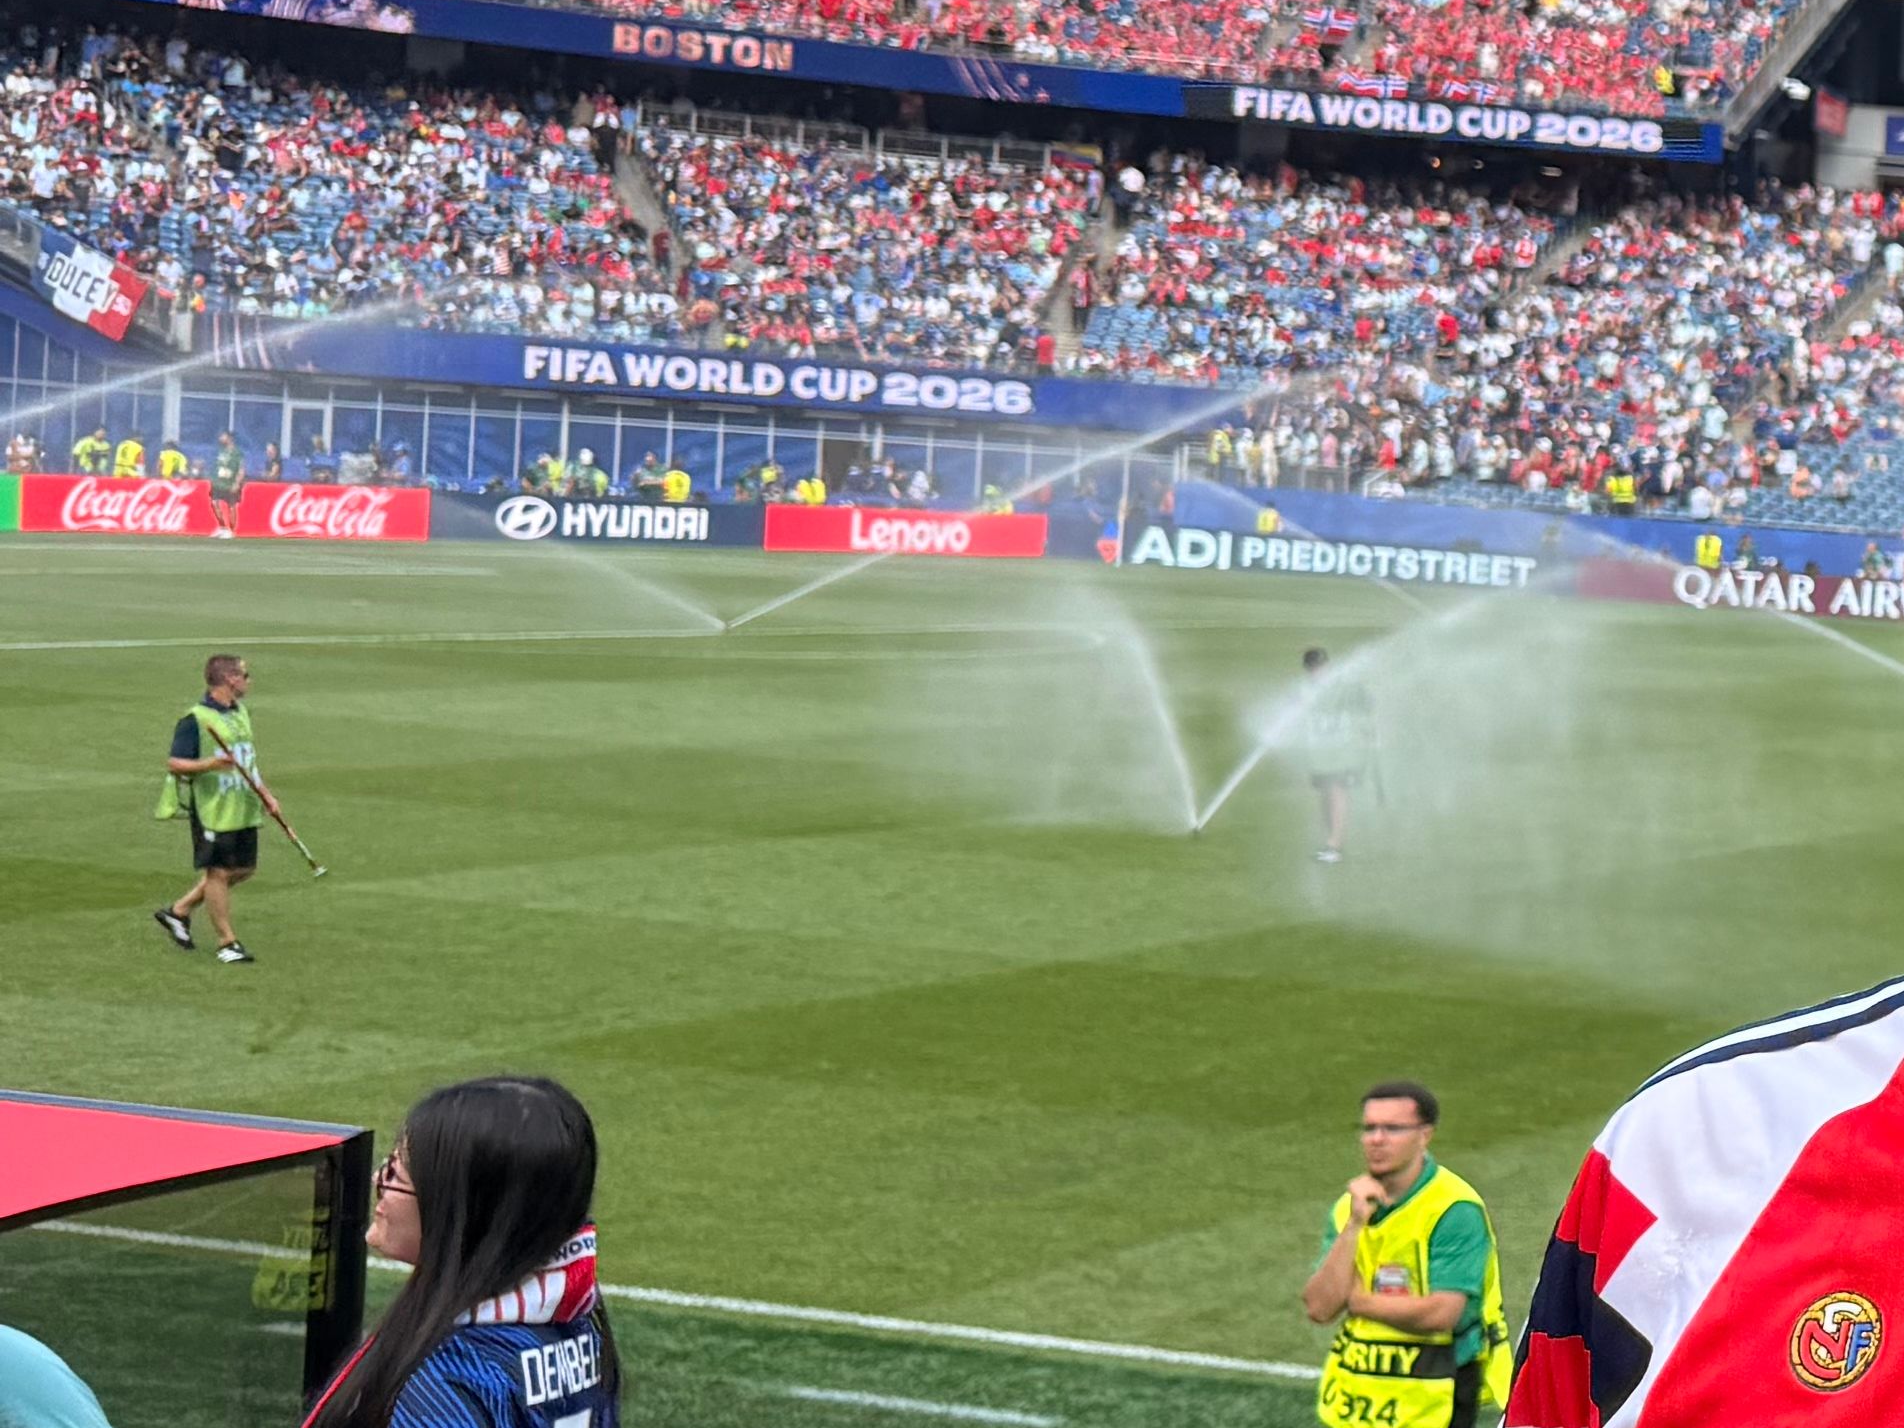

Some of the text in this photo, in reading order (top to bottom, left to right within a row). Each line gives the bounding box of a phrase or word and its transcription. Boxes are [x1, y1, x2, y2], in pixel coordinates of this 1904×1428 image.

[612, 23, 795, 72] BOSTON
[1232, 86, 1663, 152] FIFA WORLD CUP 2026
[47, 256, 118, 309] DUCEY
[522, 345, 1031, 414] FIFA WORLD CUP 2026
[561, 501, 709, 541] HYUNDAI
[850, 511, 969, 553] Lenovo
[1130, 525, 1537, 587] ADI PREDICTSTREET
[1673, 565, 1815, 613] QATAR
[520, 1332, 601, 1406] DEMBEL
